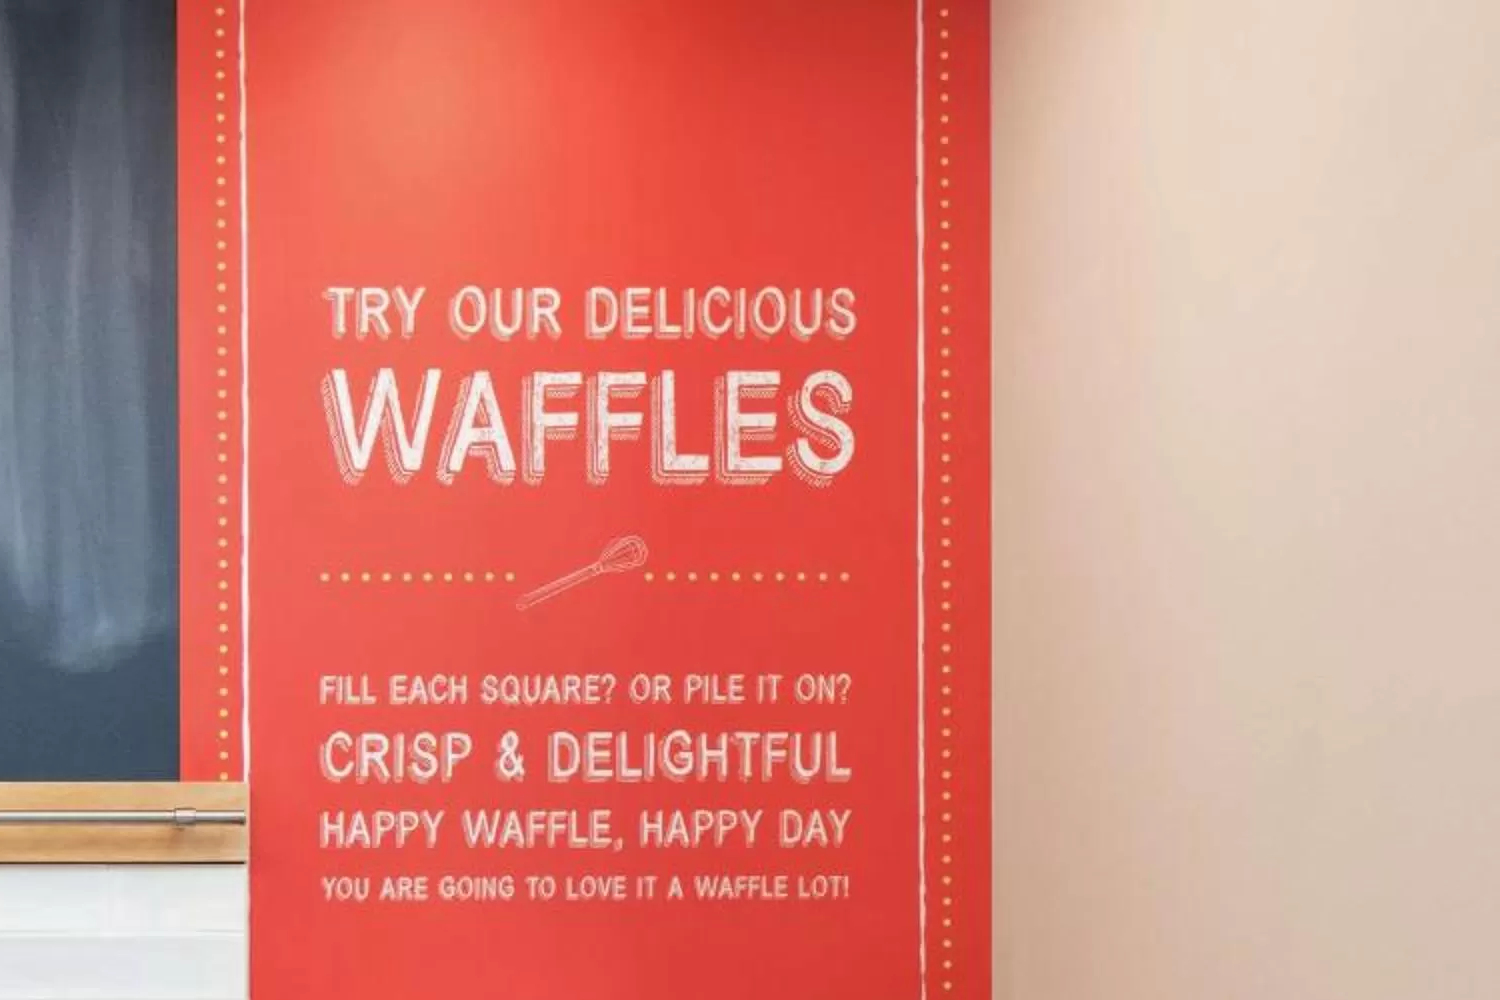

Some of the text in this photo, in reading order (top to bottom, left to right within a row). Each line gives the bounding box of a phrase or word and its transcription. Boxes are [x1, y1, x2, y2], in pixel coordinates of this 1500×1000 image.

[323, 284, 857, 340] TRY OUR DELICIOUS
[320, 367, 856, 486] WAFFLES
[318, 673, 852, 705] FILL EACH SQUARE? OR PILE IT ON?
[318, 730, 852, 784] CRISP & DELIGHTFUL
[318, 808, 852, 852] HAPPY WAFFLE, HAPPY DAY
[321, 875, 850, 903] YOU ARE GOING TO LOVE IT A WAFFLE LOT!
